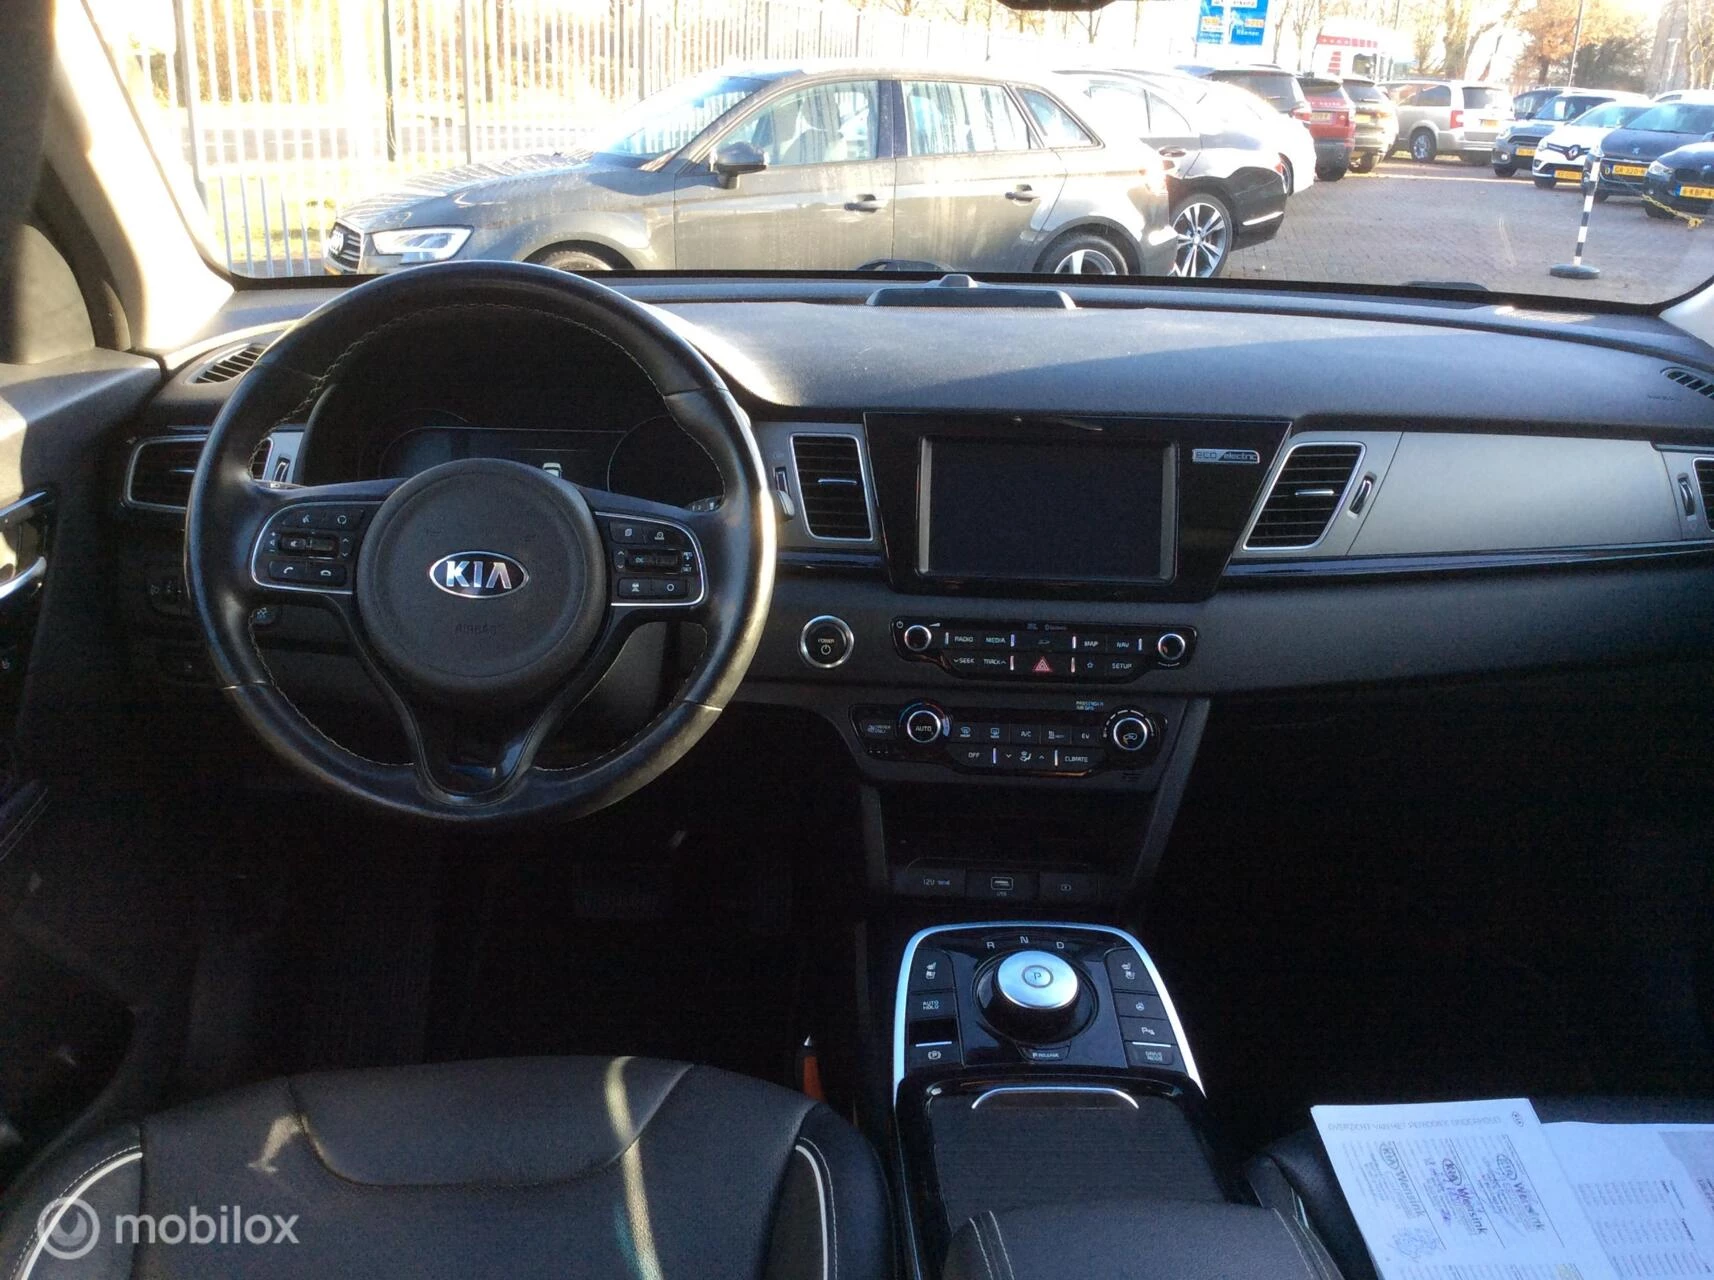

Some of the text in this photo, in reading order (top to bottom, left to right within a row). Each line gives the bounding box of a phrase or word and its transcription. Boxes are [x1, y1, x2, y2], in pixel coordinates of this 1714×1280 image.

[446, 560, 512, 589] KIA
[986, 941, 996, 949] R
[1020, 936, 1029, 944] N
[1033, 971, 1042, 980] P
[1396, 1171, 1425, 1217] Wensink
[1457, 1187, 1488, 1235] Wensink
